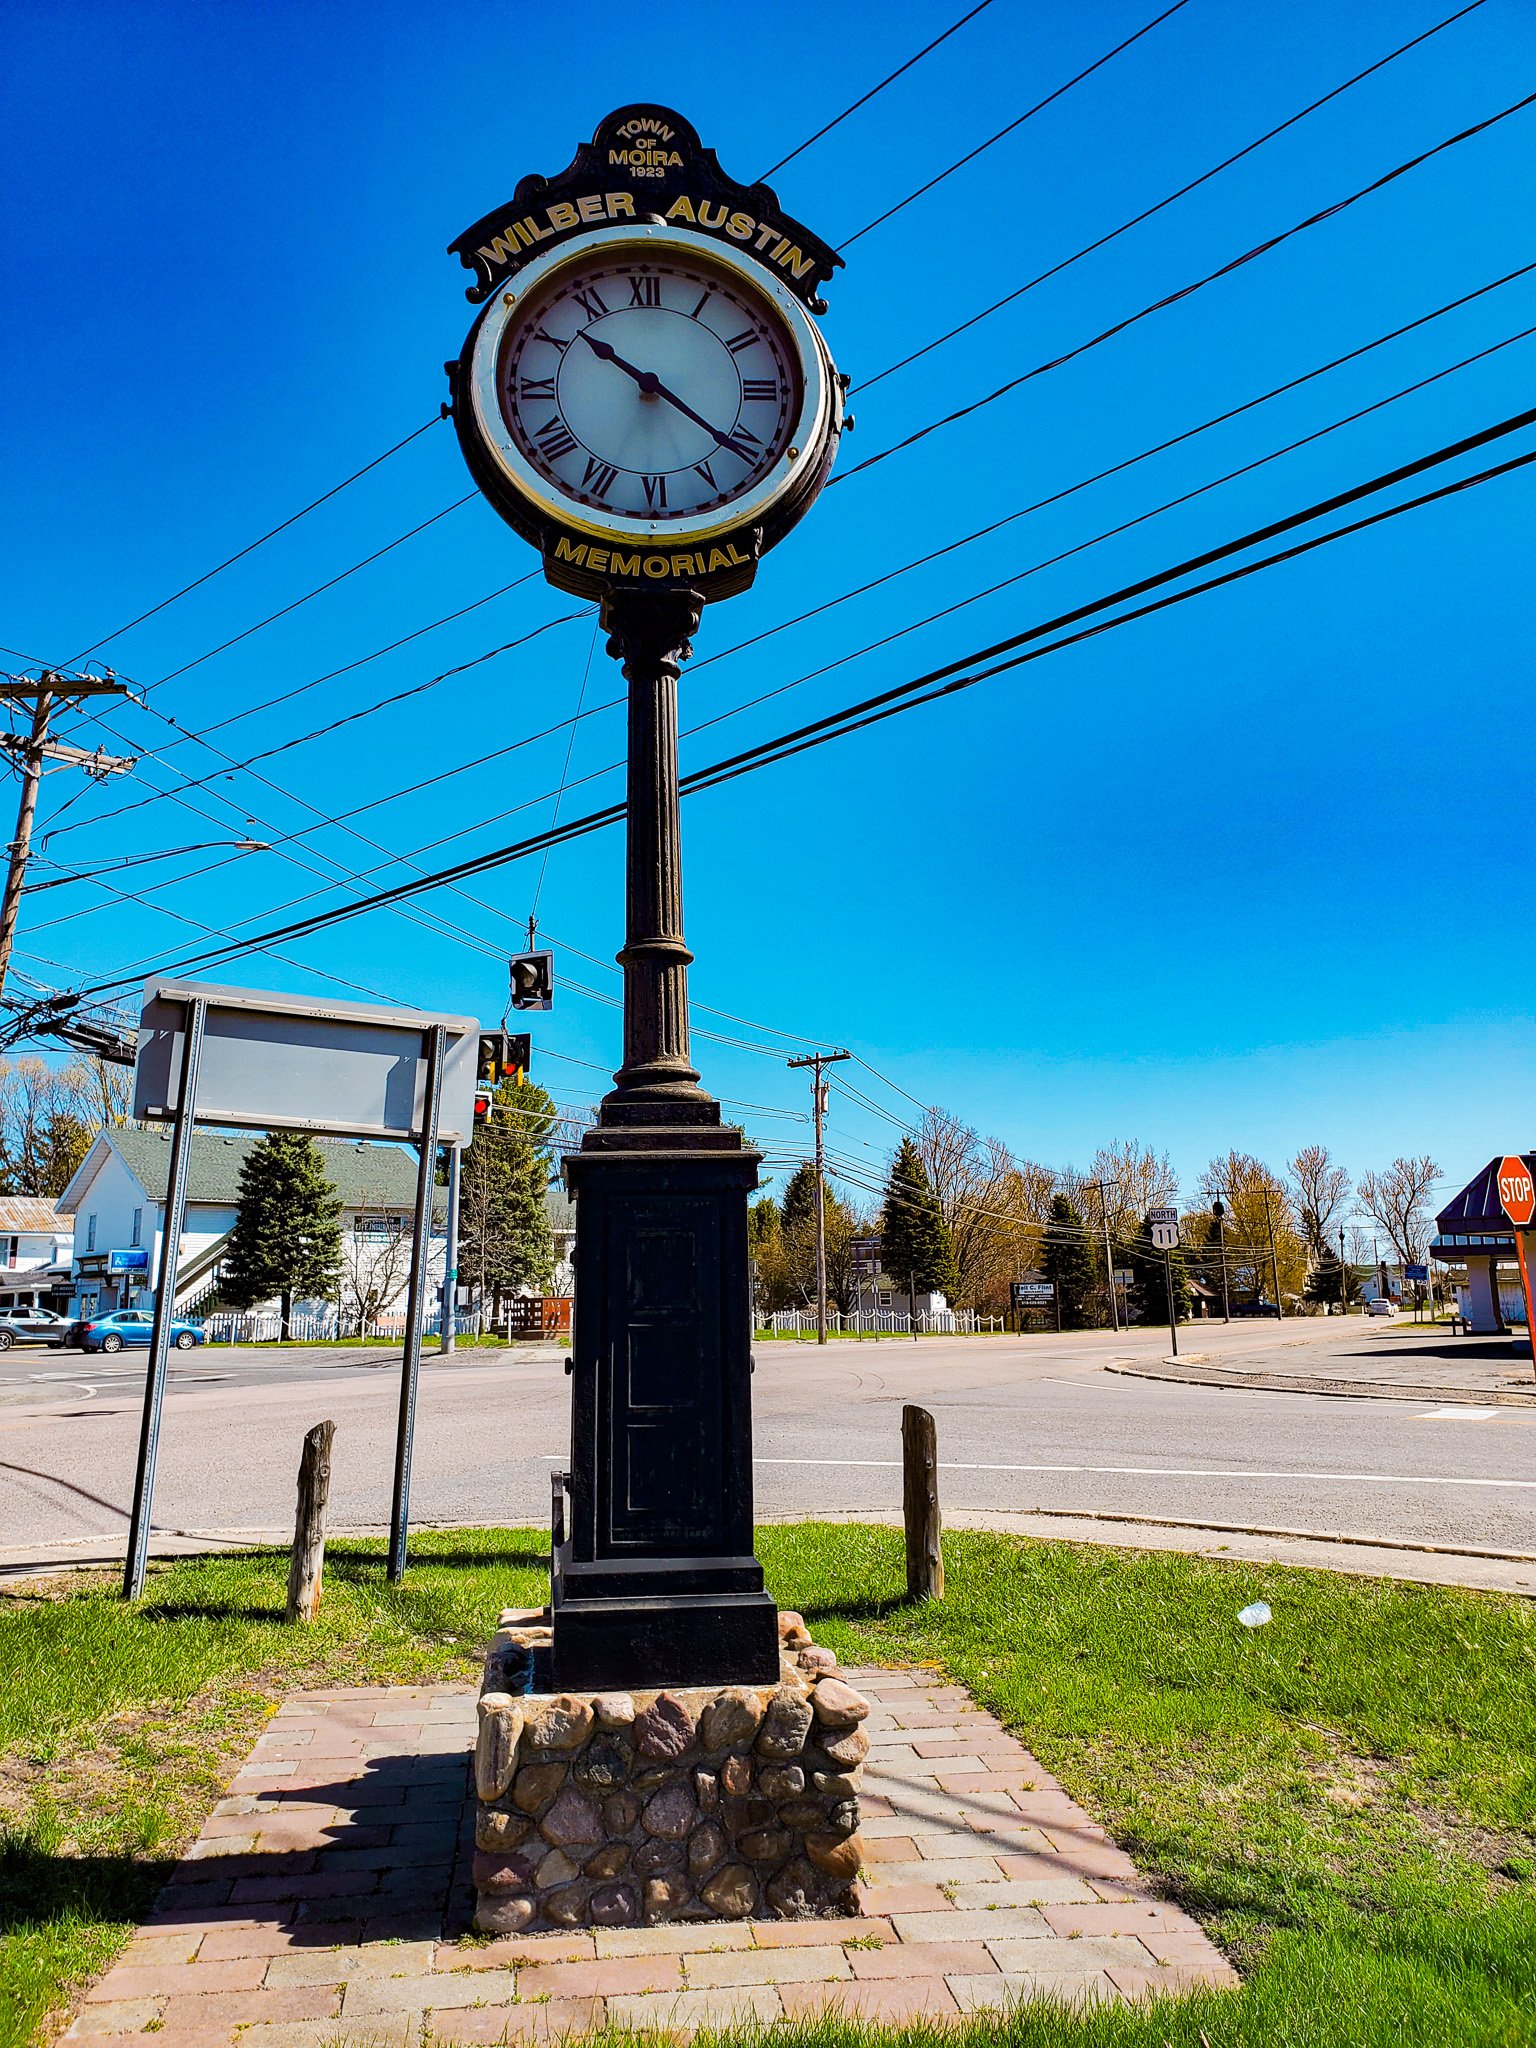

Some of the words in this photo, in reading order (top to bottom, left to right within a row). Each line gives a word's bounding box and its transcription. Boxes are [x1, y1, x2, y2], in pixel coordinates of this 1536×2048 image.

[616, 117, 675, 142] TOWN
[636, 138, 657, 149] OF
[608, 149, 684, 167] MOIRA
[629, 166, 665, 178] 1923
[476, 192, 636, 266] WILBER
[665, 195, 815, 280] AUSTIN
[572, 286, 610, 322] XI
[628, 276, 661, 307] XII
[534, 327, 570, 353] X
[521, 376, 555, 400] IX
[743, 379, 777, 401] III
[533, 415, 578, 468] VIII
[581, 456, 620, 498] VII
[641, 475, 668, 508] VI
[554, 537, 750, 578] MEMORIAL
[1501, 1177, 1530, 1202] STOP
[1150, 1210, 1176, 1219] NORTH
[1158, 1229, 1172, 1244] 11
